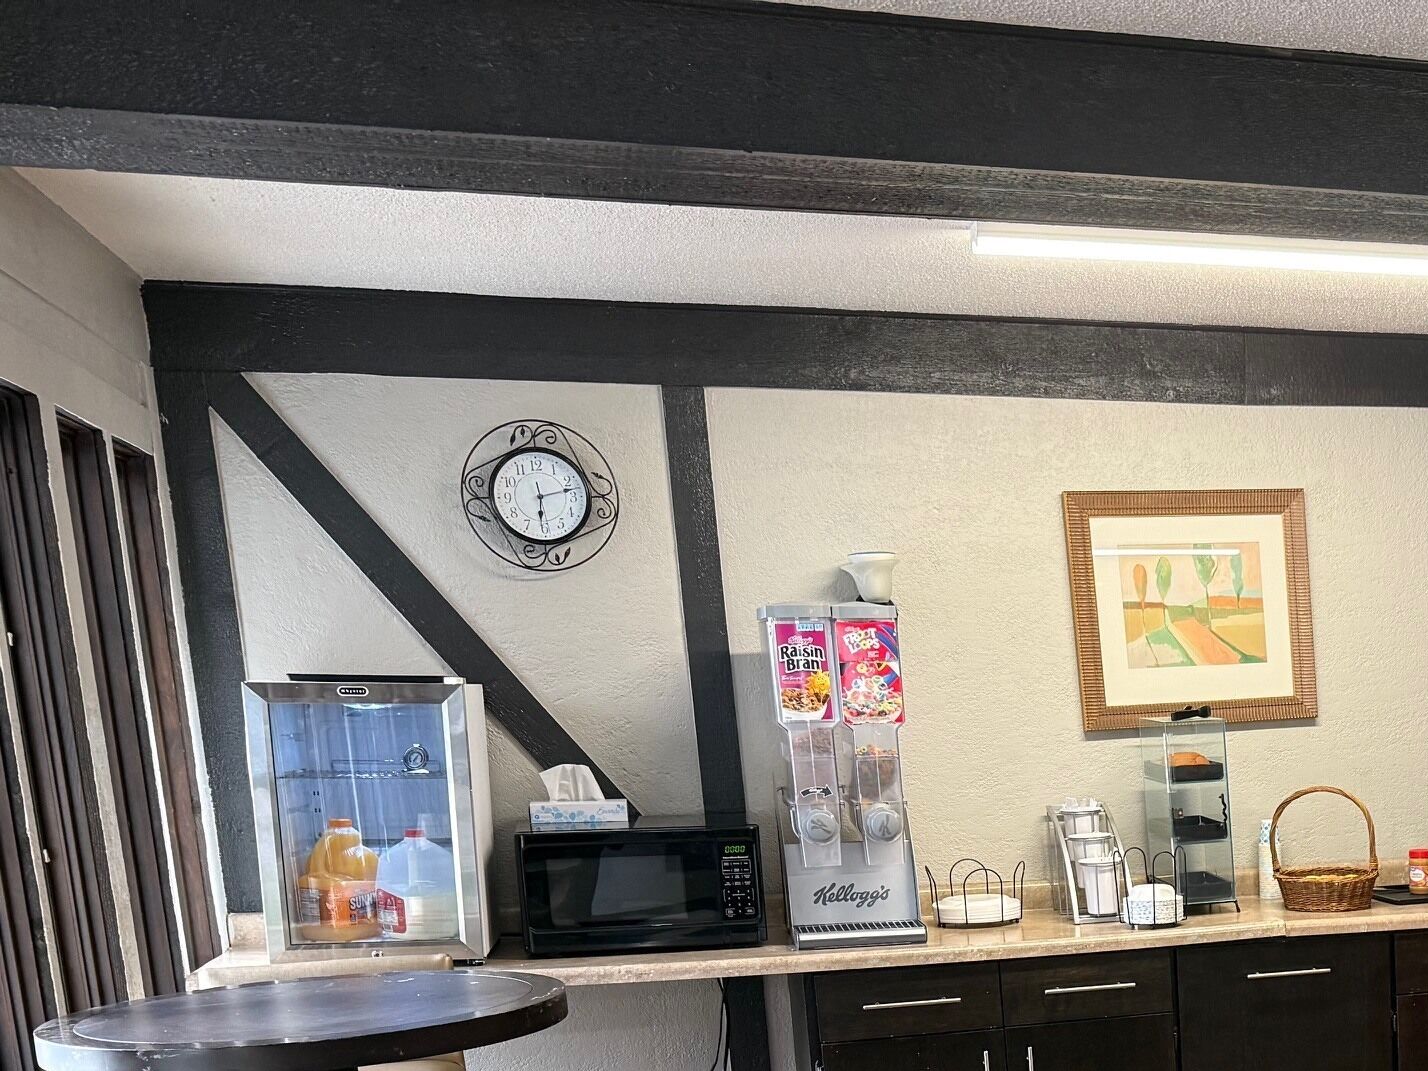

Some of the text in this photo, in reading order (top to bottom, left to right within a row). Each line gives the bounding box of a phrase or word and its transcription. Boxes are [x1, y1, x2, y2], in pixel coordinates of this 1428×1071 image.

[516, 463, 525, 476] 11
[530, 460, 543, 472] 12
[551, 464, 556, 476] 1
[505, 476, 516, 488] 10
[563, 475, 571, 487] 2
[503, 492, 512, 504] 9
[569, 491, 577, 503] 3
[510, 506, 518, 519] 8
[523, 519, 531, 531] 7
[541, 521, 549, 535] 6
[557, 517, 565, 530] 5
[779, 645, 824, 660] Raisin
[786, 658, 820, 671] Bran
[813, 882, 891, 908] Kellogg's
